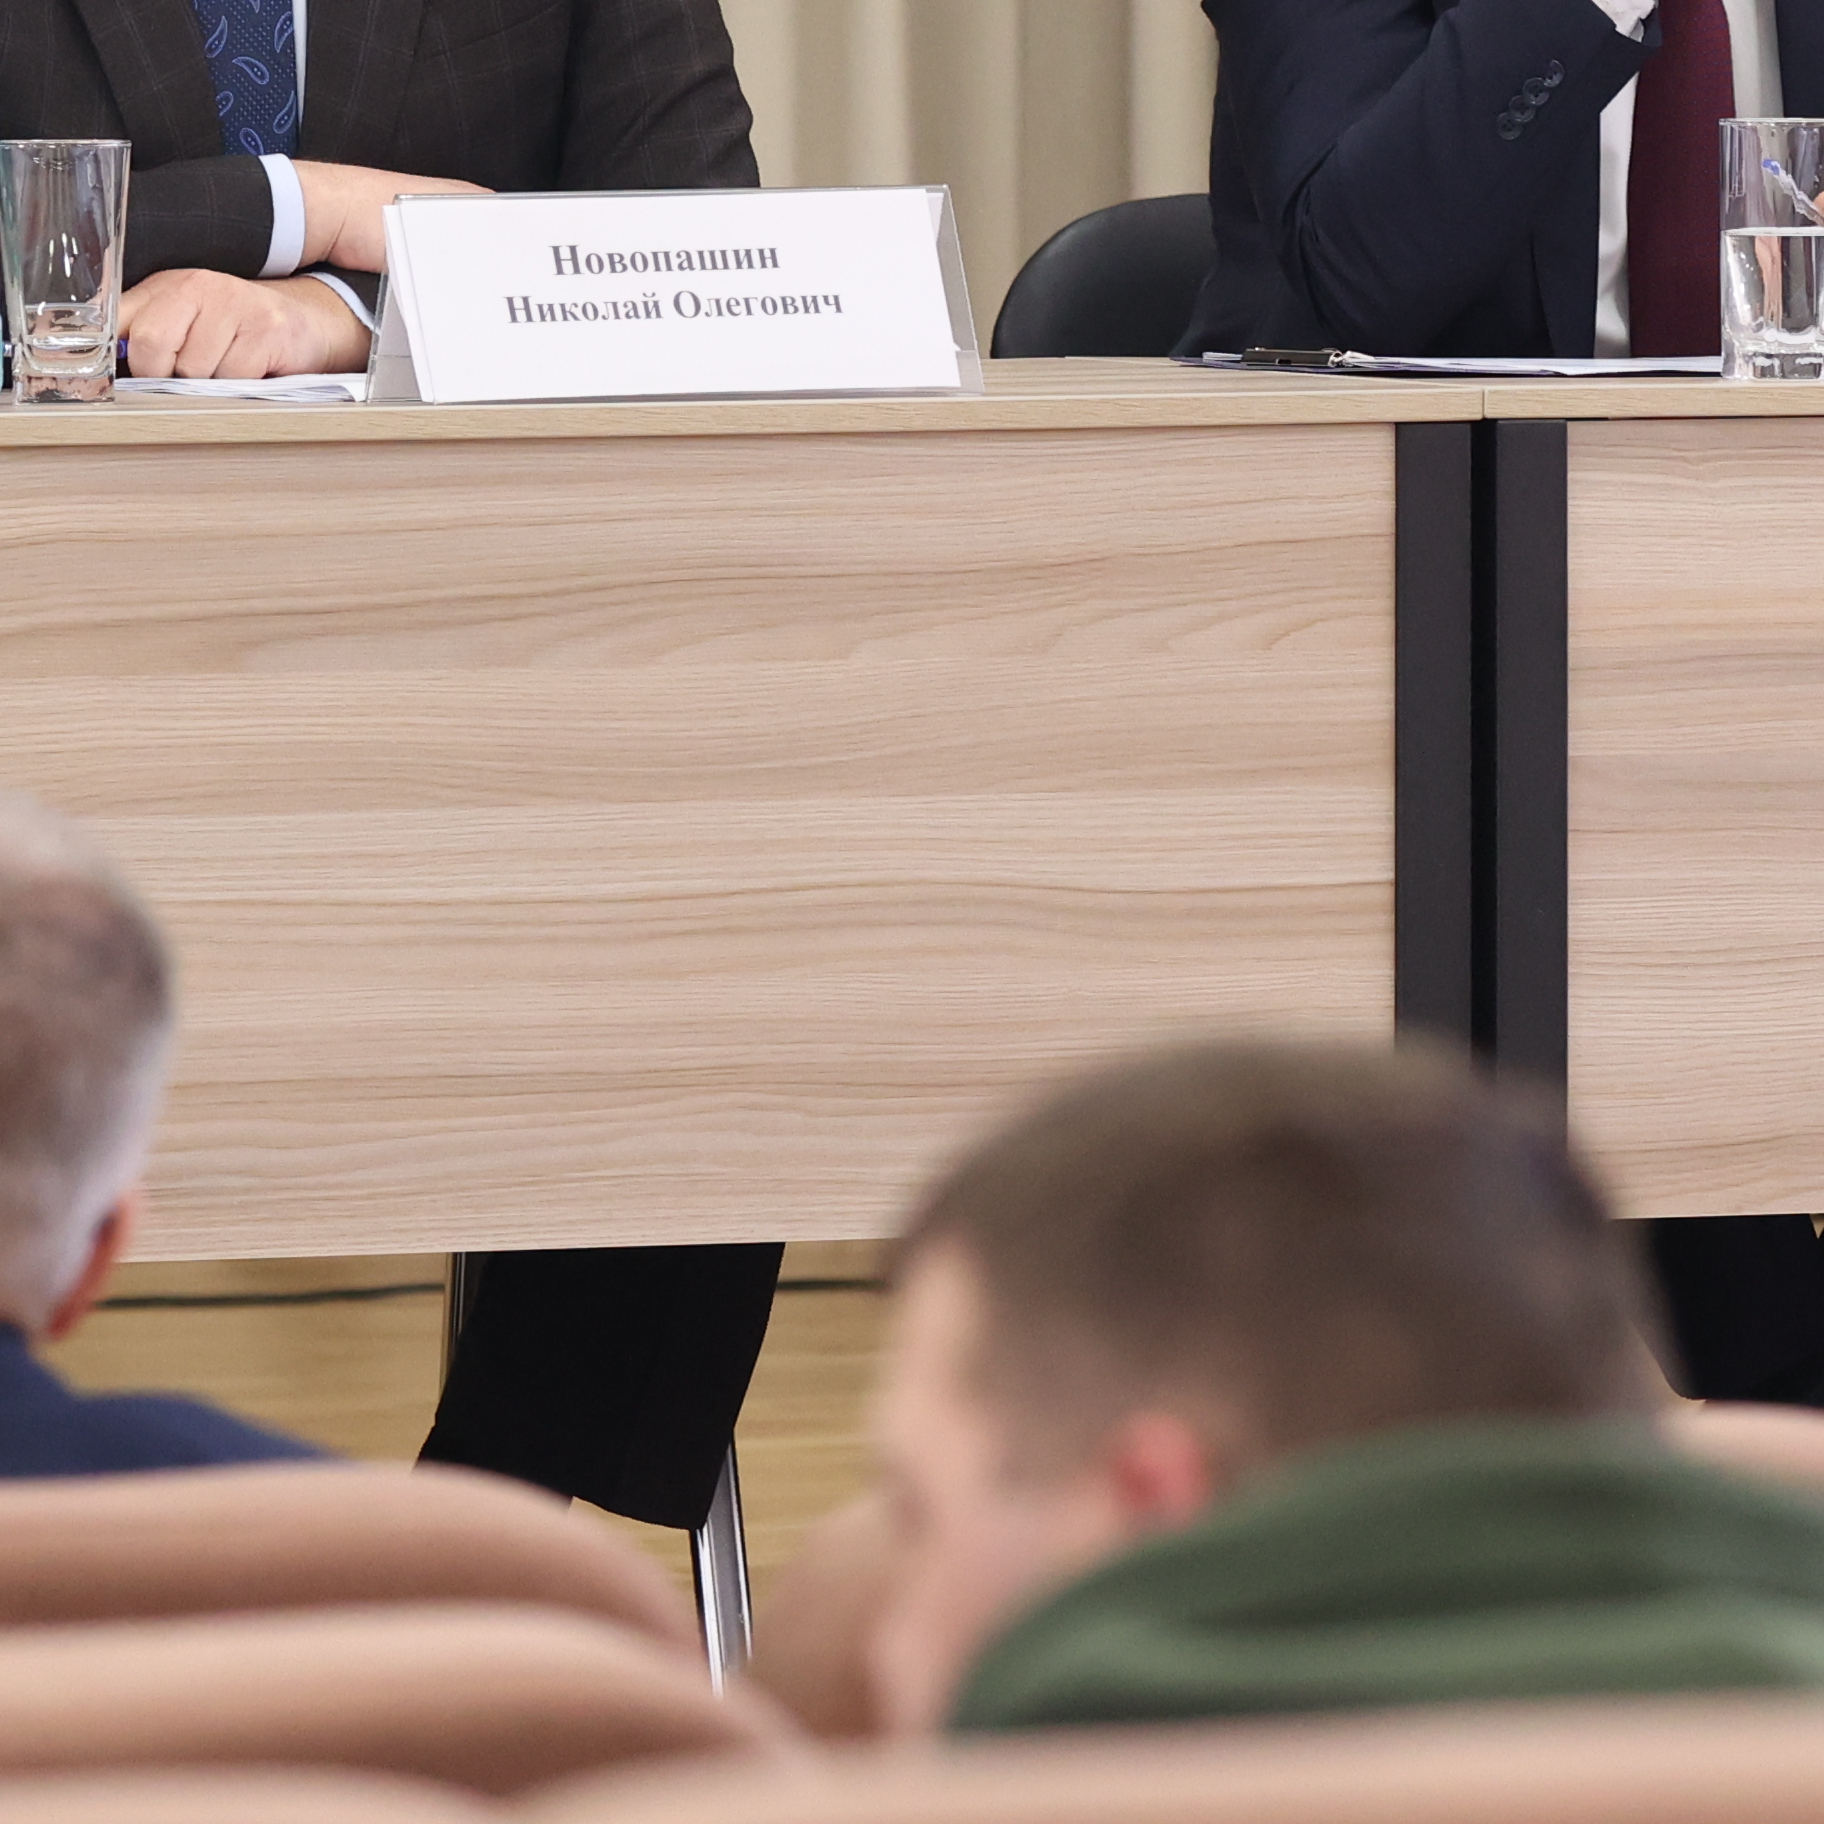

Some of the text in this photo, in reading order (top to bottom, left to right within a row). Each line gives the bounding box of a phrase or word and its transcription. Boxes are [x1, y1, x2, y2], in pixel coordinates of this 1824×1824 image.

[548, 243, 781, 276] Новопашин
[504, 290, 843, 325] Николай Олегович
